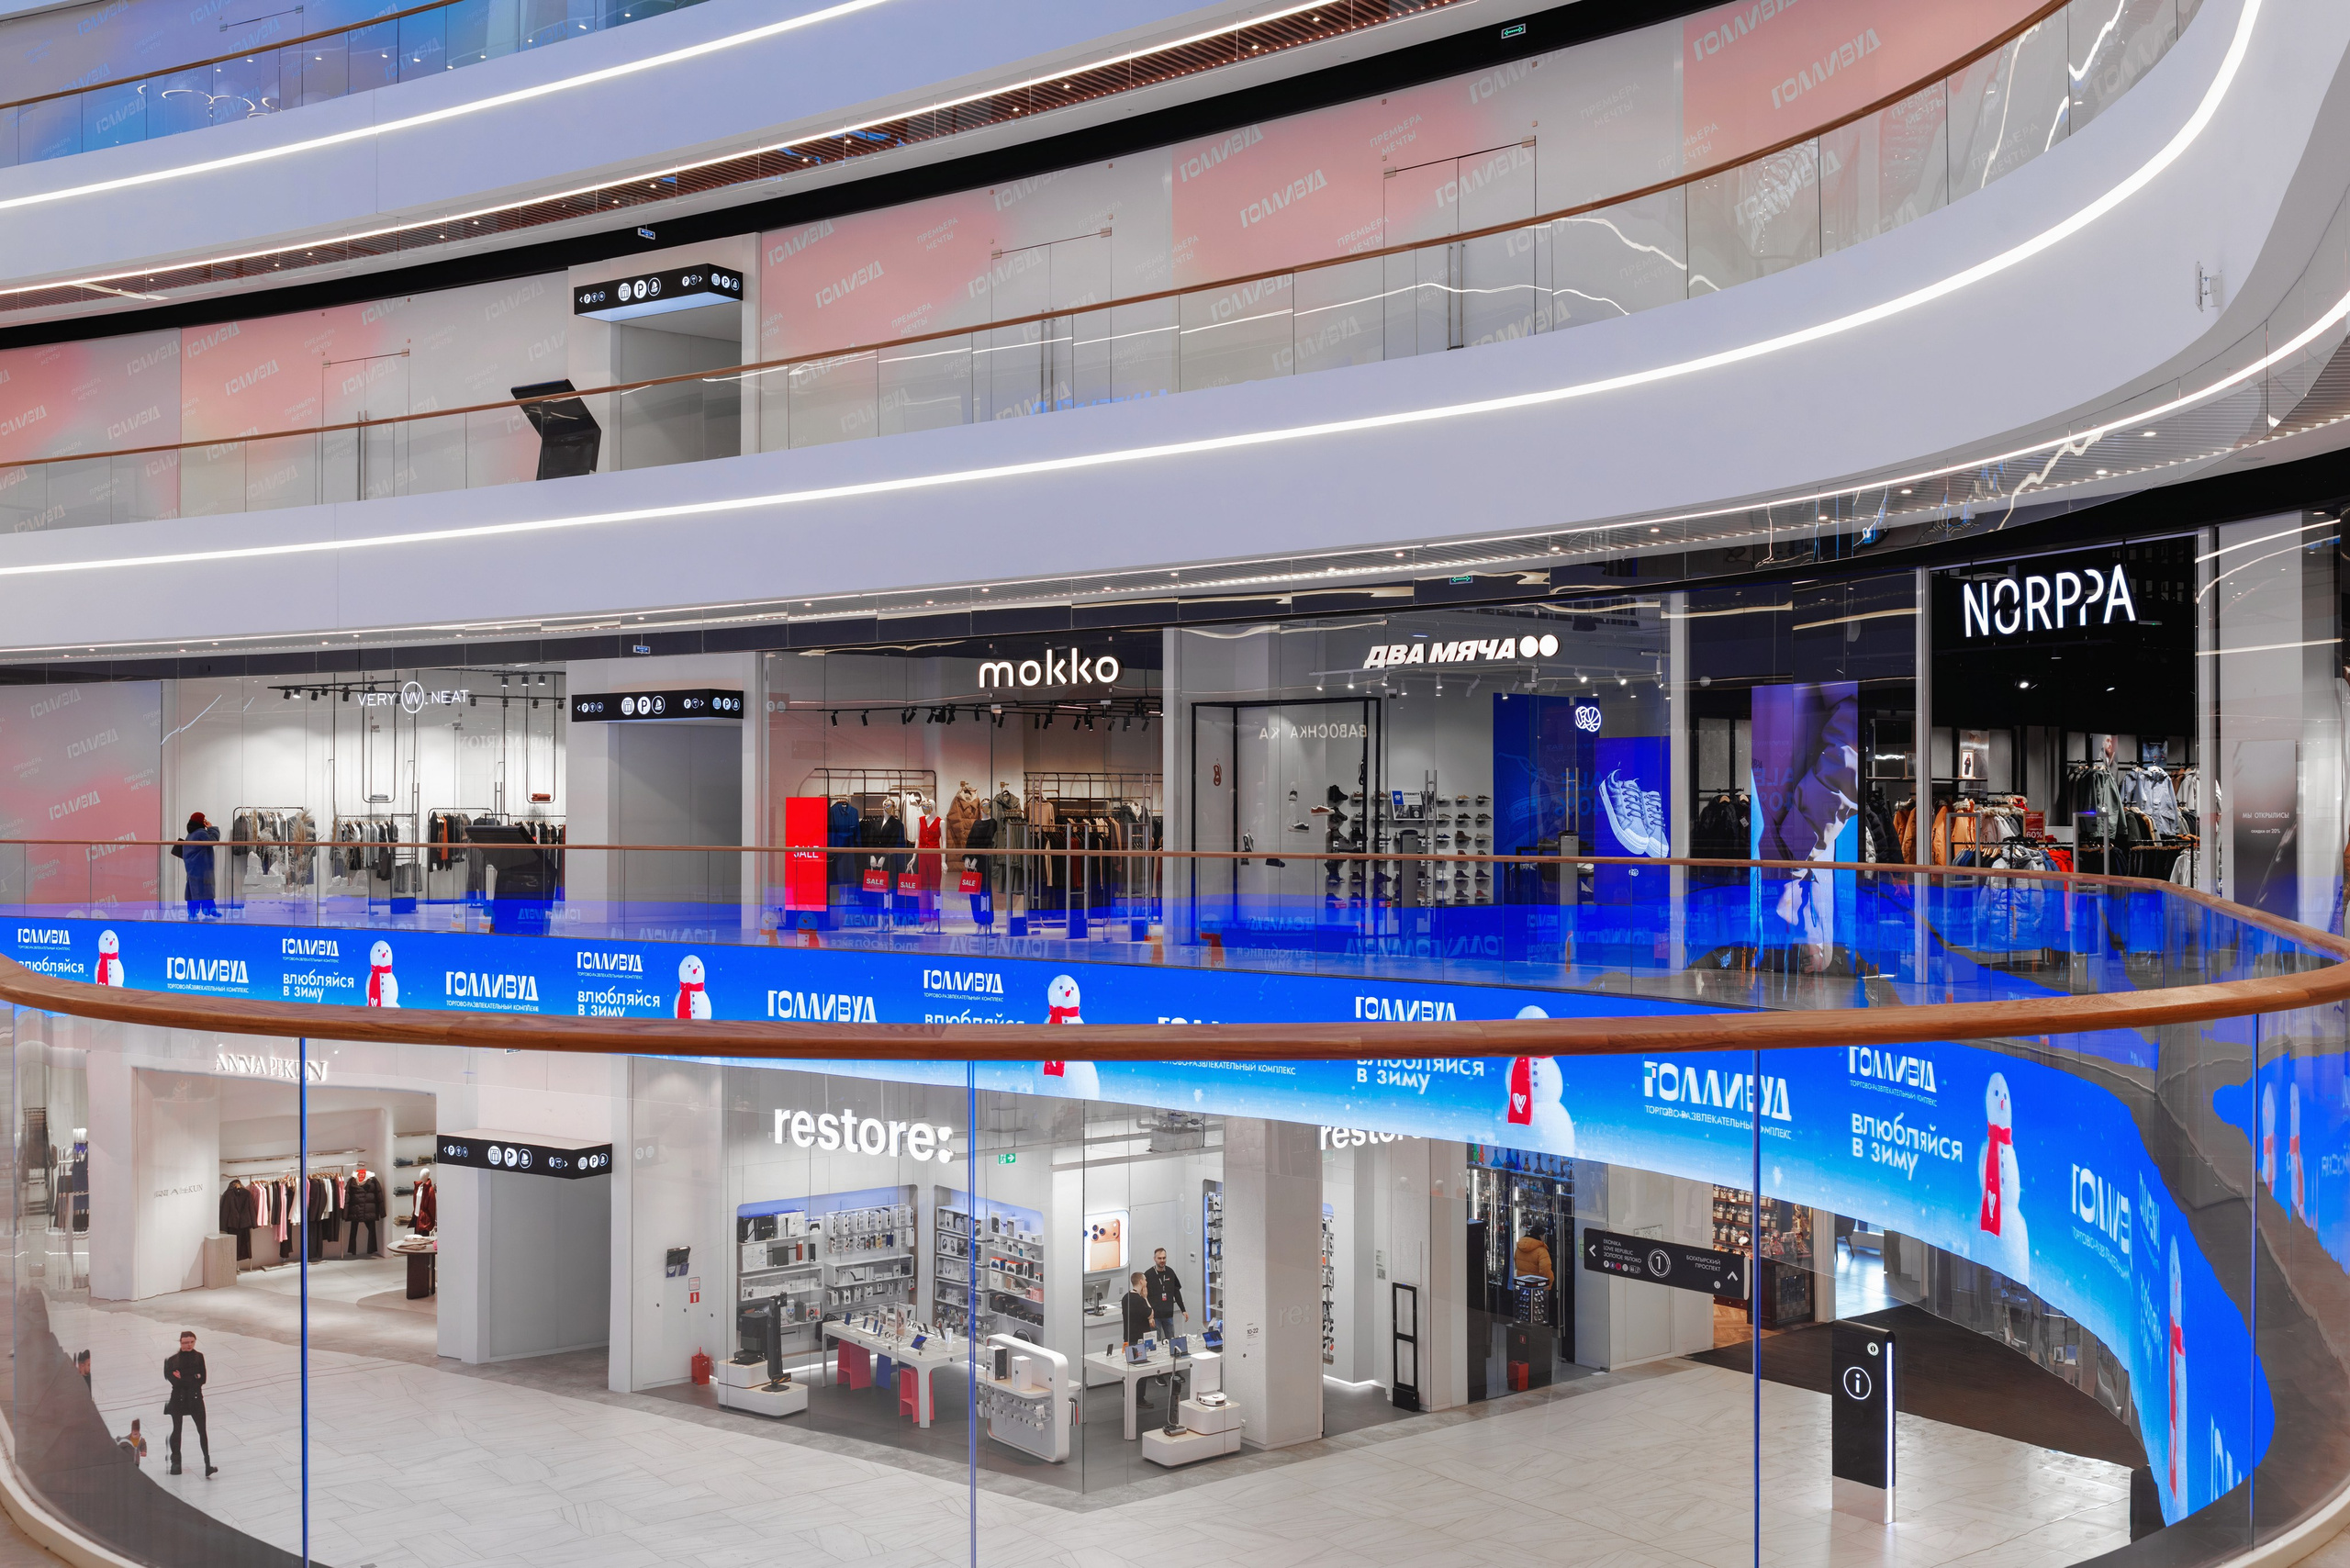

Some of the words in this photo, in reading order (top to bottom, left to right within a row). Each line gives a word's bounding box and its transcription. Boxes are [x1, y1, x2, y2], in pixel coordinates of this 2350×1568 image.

[1771, 28, 1882, 110] ГОЛЛИВУД
[1370, 114, 1423, 148] ПРЕМЬЕРА
[1382, 130, 1416, 155] МЕЧТЫ
[1180, 125, 1263, 182] ГОЛЛИВУД
[1435, 144, 1534, 208] ГОЛЛИВУД
[1240, 169, 1327, 228] ГОЛЛИВУД
[767, 219, 834, 266] ГОЛЛИВУД
[916, 218, 958, 243] ПРЕМЬЕРА
[925, 230, 954, 252] МЕЧТЫ
[1337, 216, 1390, 248] ПРЕМЬЕРА
[815, 260, 885, 308] ГОЛЛИВУД
[968, 249, 1043, 298] ГОЛЛИВУД
[890, 303, 933, 329] ПРЕМЬЕРА
[900, 316, 927, 336] МЕЧТЫ
[225, 359, 279, 396] ГОЛЛИВУД
[107, 405, 161, 440] ГОЛЛИВУД
[1964, 564, 2136, 637] NORPPA
[1363, 644, 1425, 668] ДВА
[1428, 638, 1516, 663] МЯЧА
[979, 648, 1119, 688] mokko
[357, 693, 396, 706] VERY
[431, 689, 469, 704] NEAT
[49, 790, 101, 821] ГОЛЛИВУД
[2026, 831, 2042, 839] 60%
[866, 878, 884, 886] SALE
[962, 879, 976, 887] SALE
[17, 928, 70, 945] ГОЛЛИВУД
[282, 938, 339, 957] ГОЛЛИВУД
[166, 957, 249, 983] ГОЛЛИВУД
[577, 951, 643, 972] ГОЛЛИВУД
[283, 969, 354, 989] влюбляйся
[445, 971, 539, 1001] ГОЛЛИВУД
[923, 969, 1003, 993] ГОЛЛИВУД
[284, 986, 289, 996] в
[295, 987, 324, 1002] зиму
[577, 986, 660, 1007] влюбляйся
[767, 990, 878, 1023] ГОЛЛИВУД
[578, 1004, 585, 1016] в
[215, 1053, 267, 1076] ANNA
[1258, 1065, 1296, 1076] КОМПЛЕКС
[1849, 1047, 1937, 1093] ГОЛЛИВУД
[1357, 1070, 1368, 1083] в
[1377, 1070, 1431, 1094] зиму
[774, 1109, 955, 1164] restore:
[1852, 1112, 1963, 1163] влюбляйся
[1852, 1137, 1863, 1158] в
[1871, 1146, 1919, 1181] зиму
[1603, 1245, 1614, 1253] LOVE
[1614, 1247, 1634, 1256] REPUBLIC
[1603, 1251, 1624, 1260] ЗОЛОТОЕ
[1624, 1254, 1642, 1263] ЯБЛОКО
[1685, 1254, 1721, 1266] БОГАТЫРСКИЙ
[1695, 1262, 1721, 1272] ПРОСПЕКТ
[1279, 1304, 1311, 1328] re:
